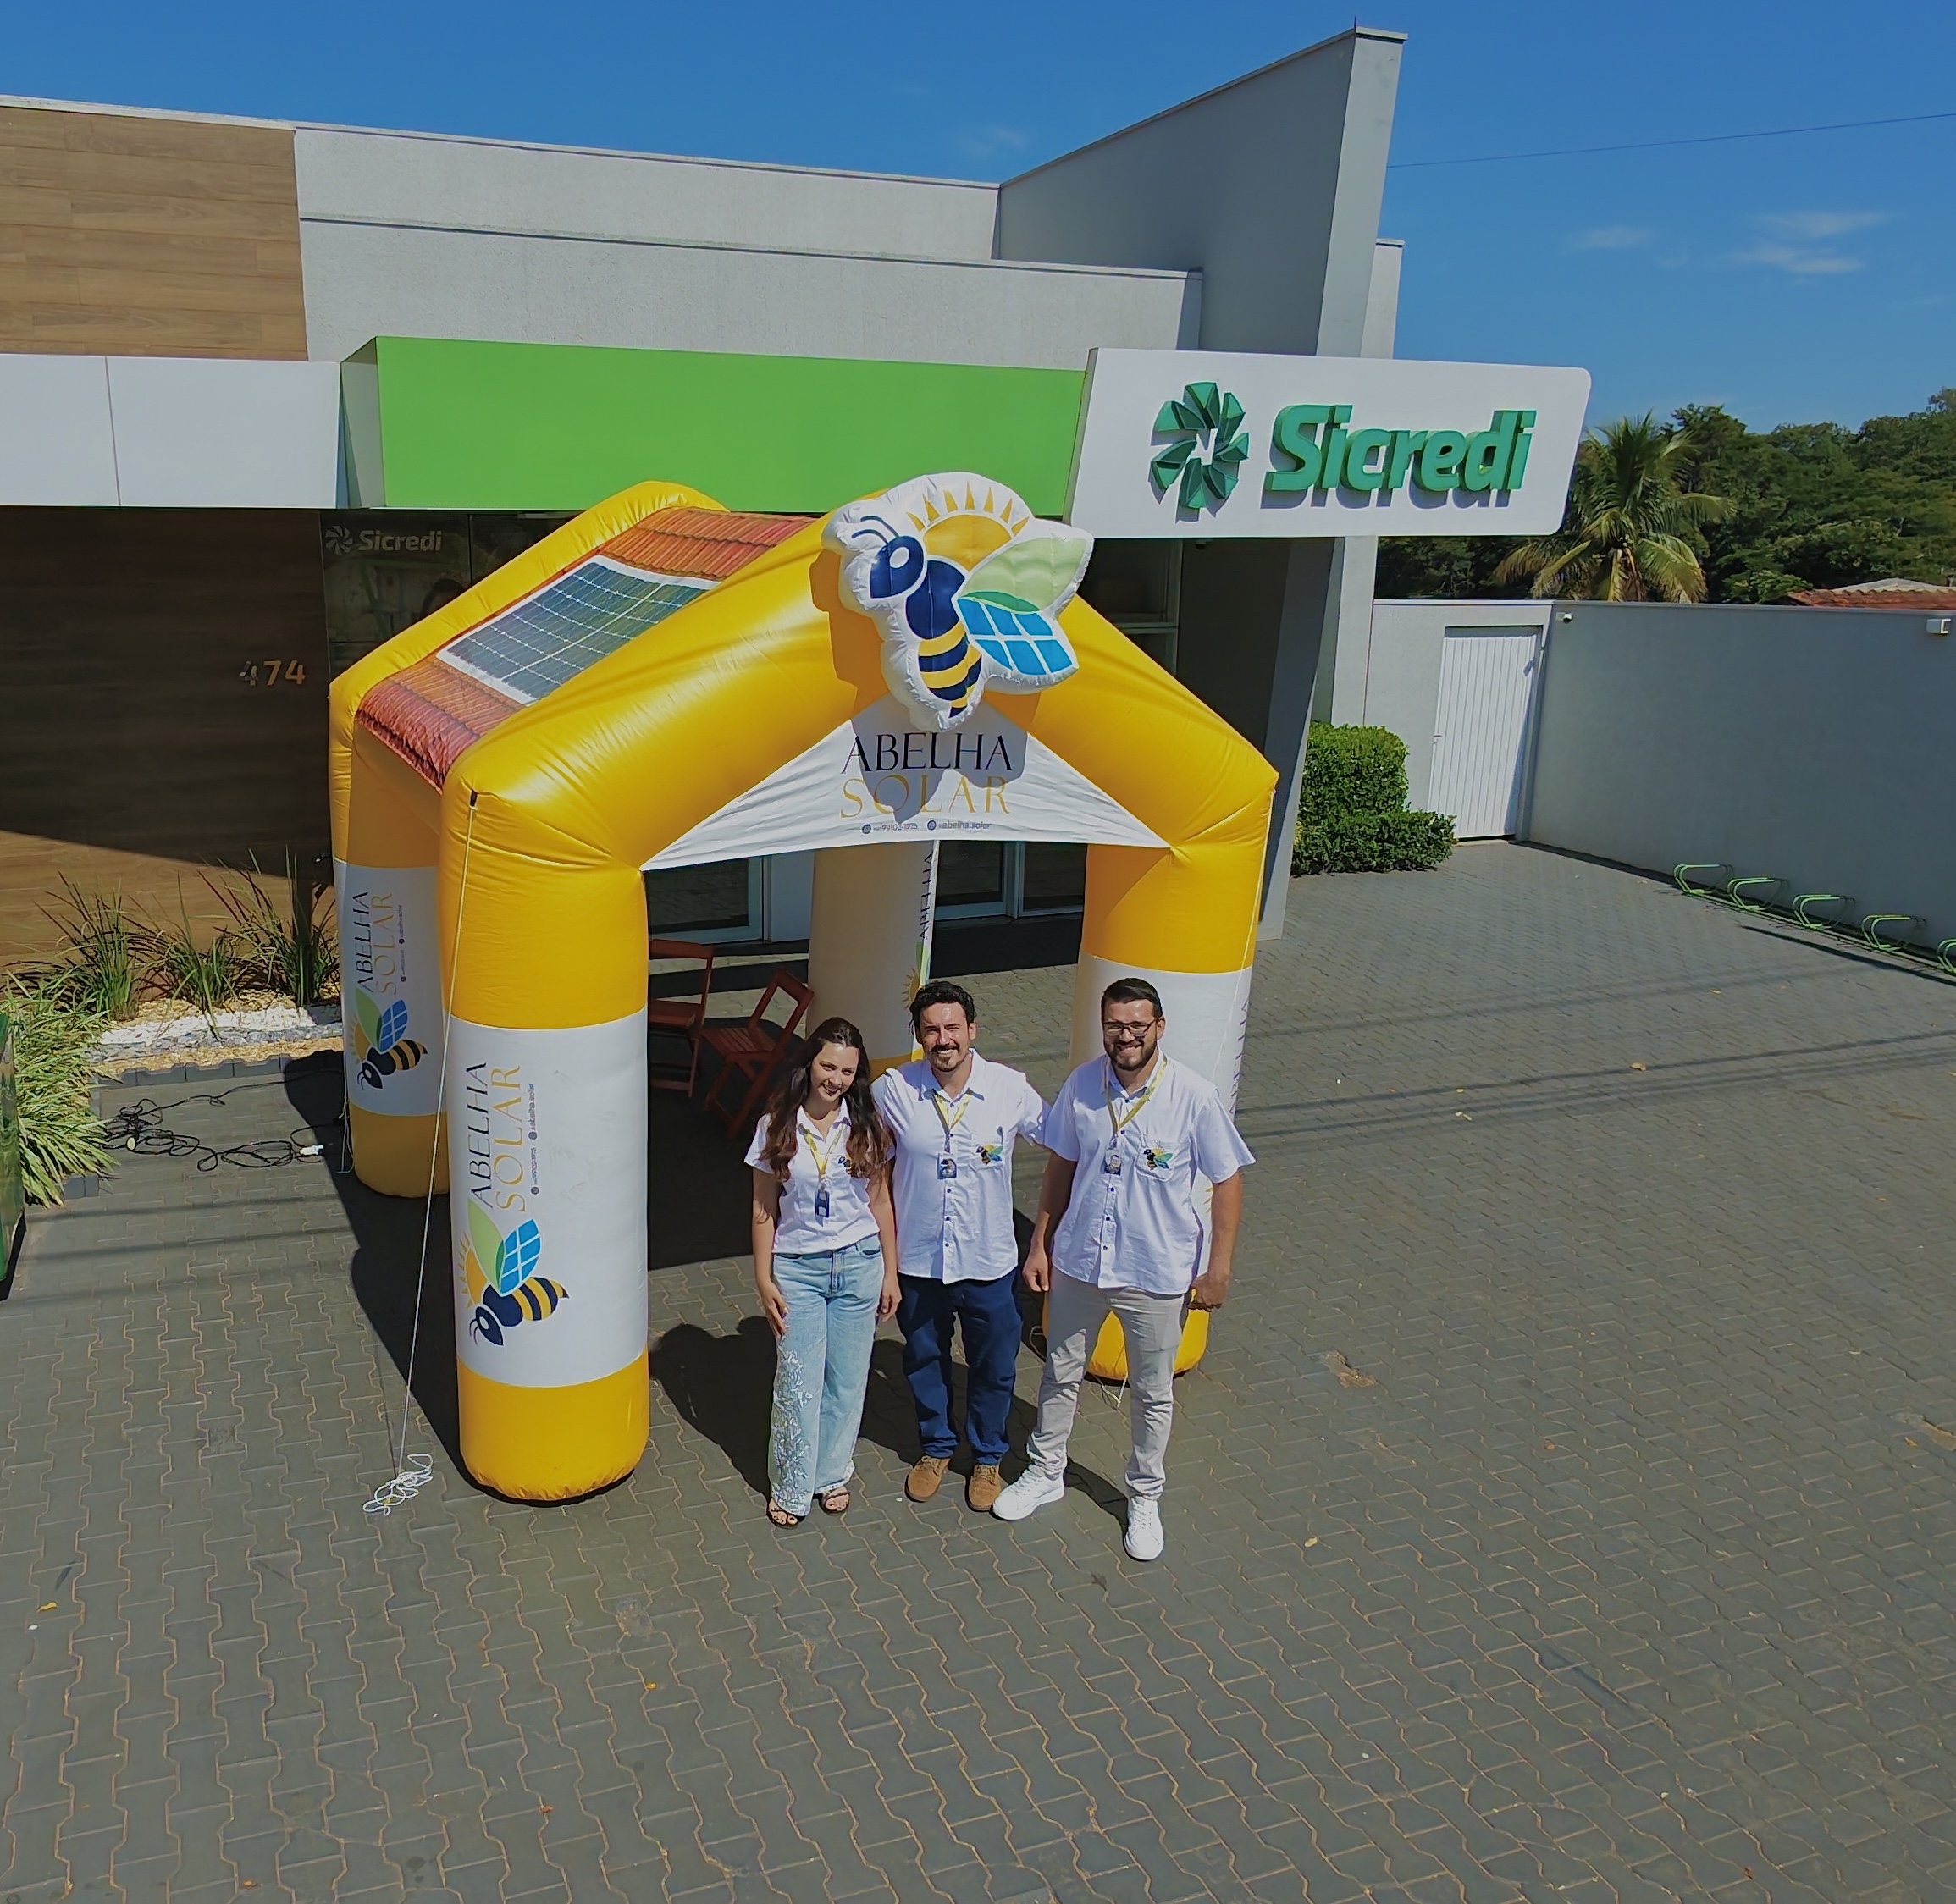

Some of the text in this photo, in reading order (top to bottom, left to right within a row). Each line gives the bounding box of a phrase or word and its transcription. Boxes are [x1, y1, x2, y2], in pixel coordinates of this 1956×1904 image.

[1264, 402, 1538, 493] Sicredi
[357, 529, 442, 551] Sicredi
[239, 660, 306, 686] 474
[839, 774, 1010, 819] SOLAR
[840, 731, 1014, 775] ABELHA
[352, 891, 375, 993] ABELHA
[371, 892, 397, 995] SOLAR
[466, 1061, 494, 1210] ABELHA
[490, 1064, 527, 1213] SOLAR
